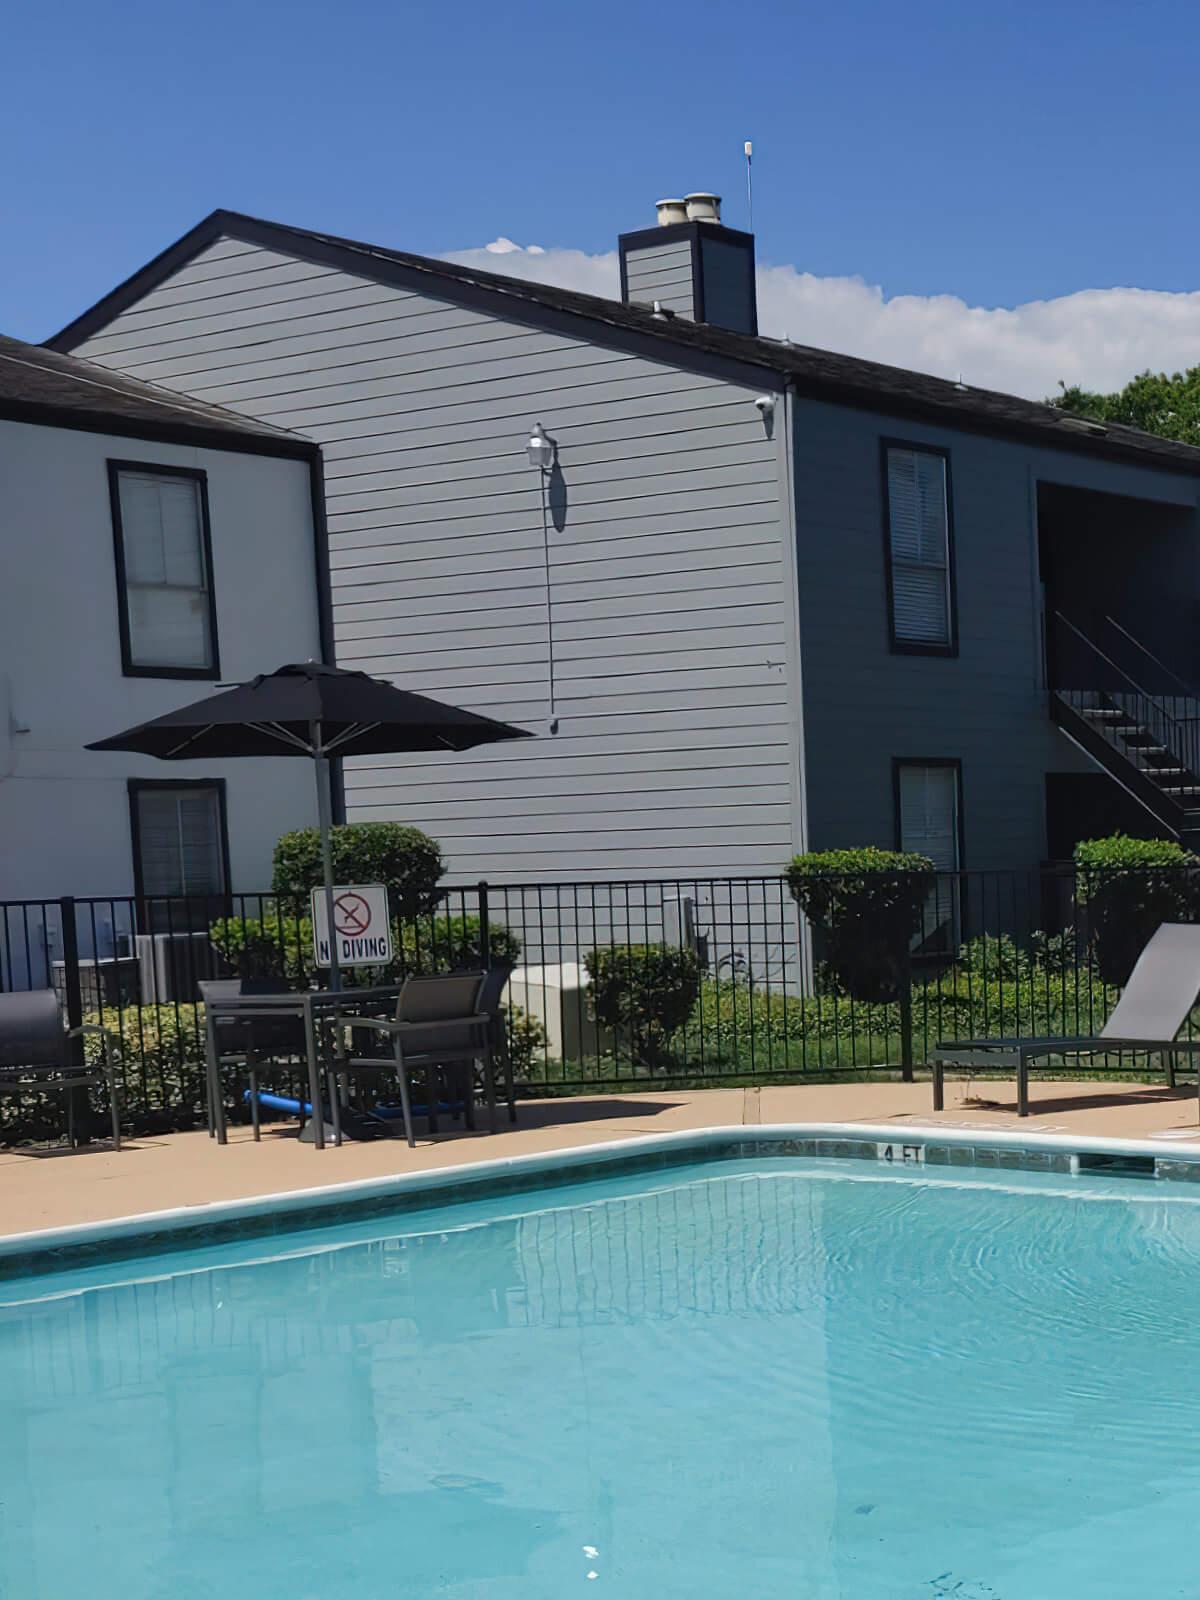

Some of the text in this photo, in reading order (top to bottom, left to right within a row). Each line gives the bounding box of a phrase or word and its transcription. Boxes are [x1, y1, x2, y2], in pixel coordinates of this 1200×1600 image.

[320, 937, 386, 960] N DIVING
[884, 1145, 921, 1163] 4 FT
